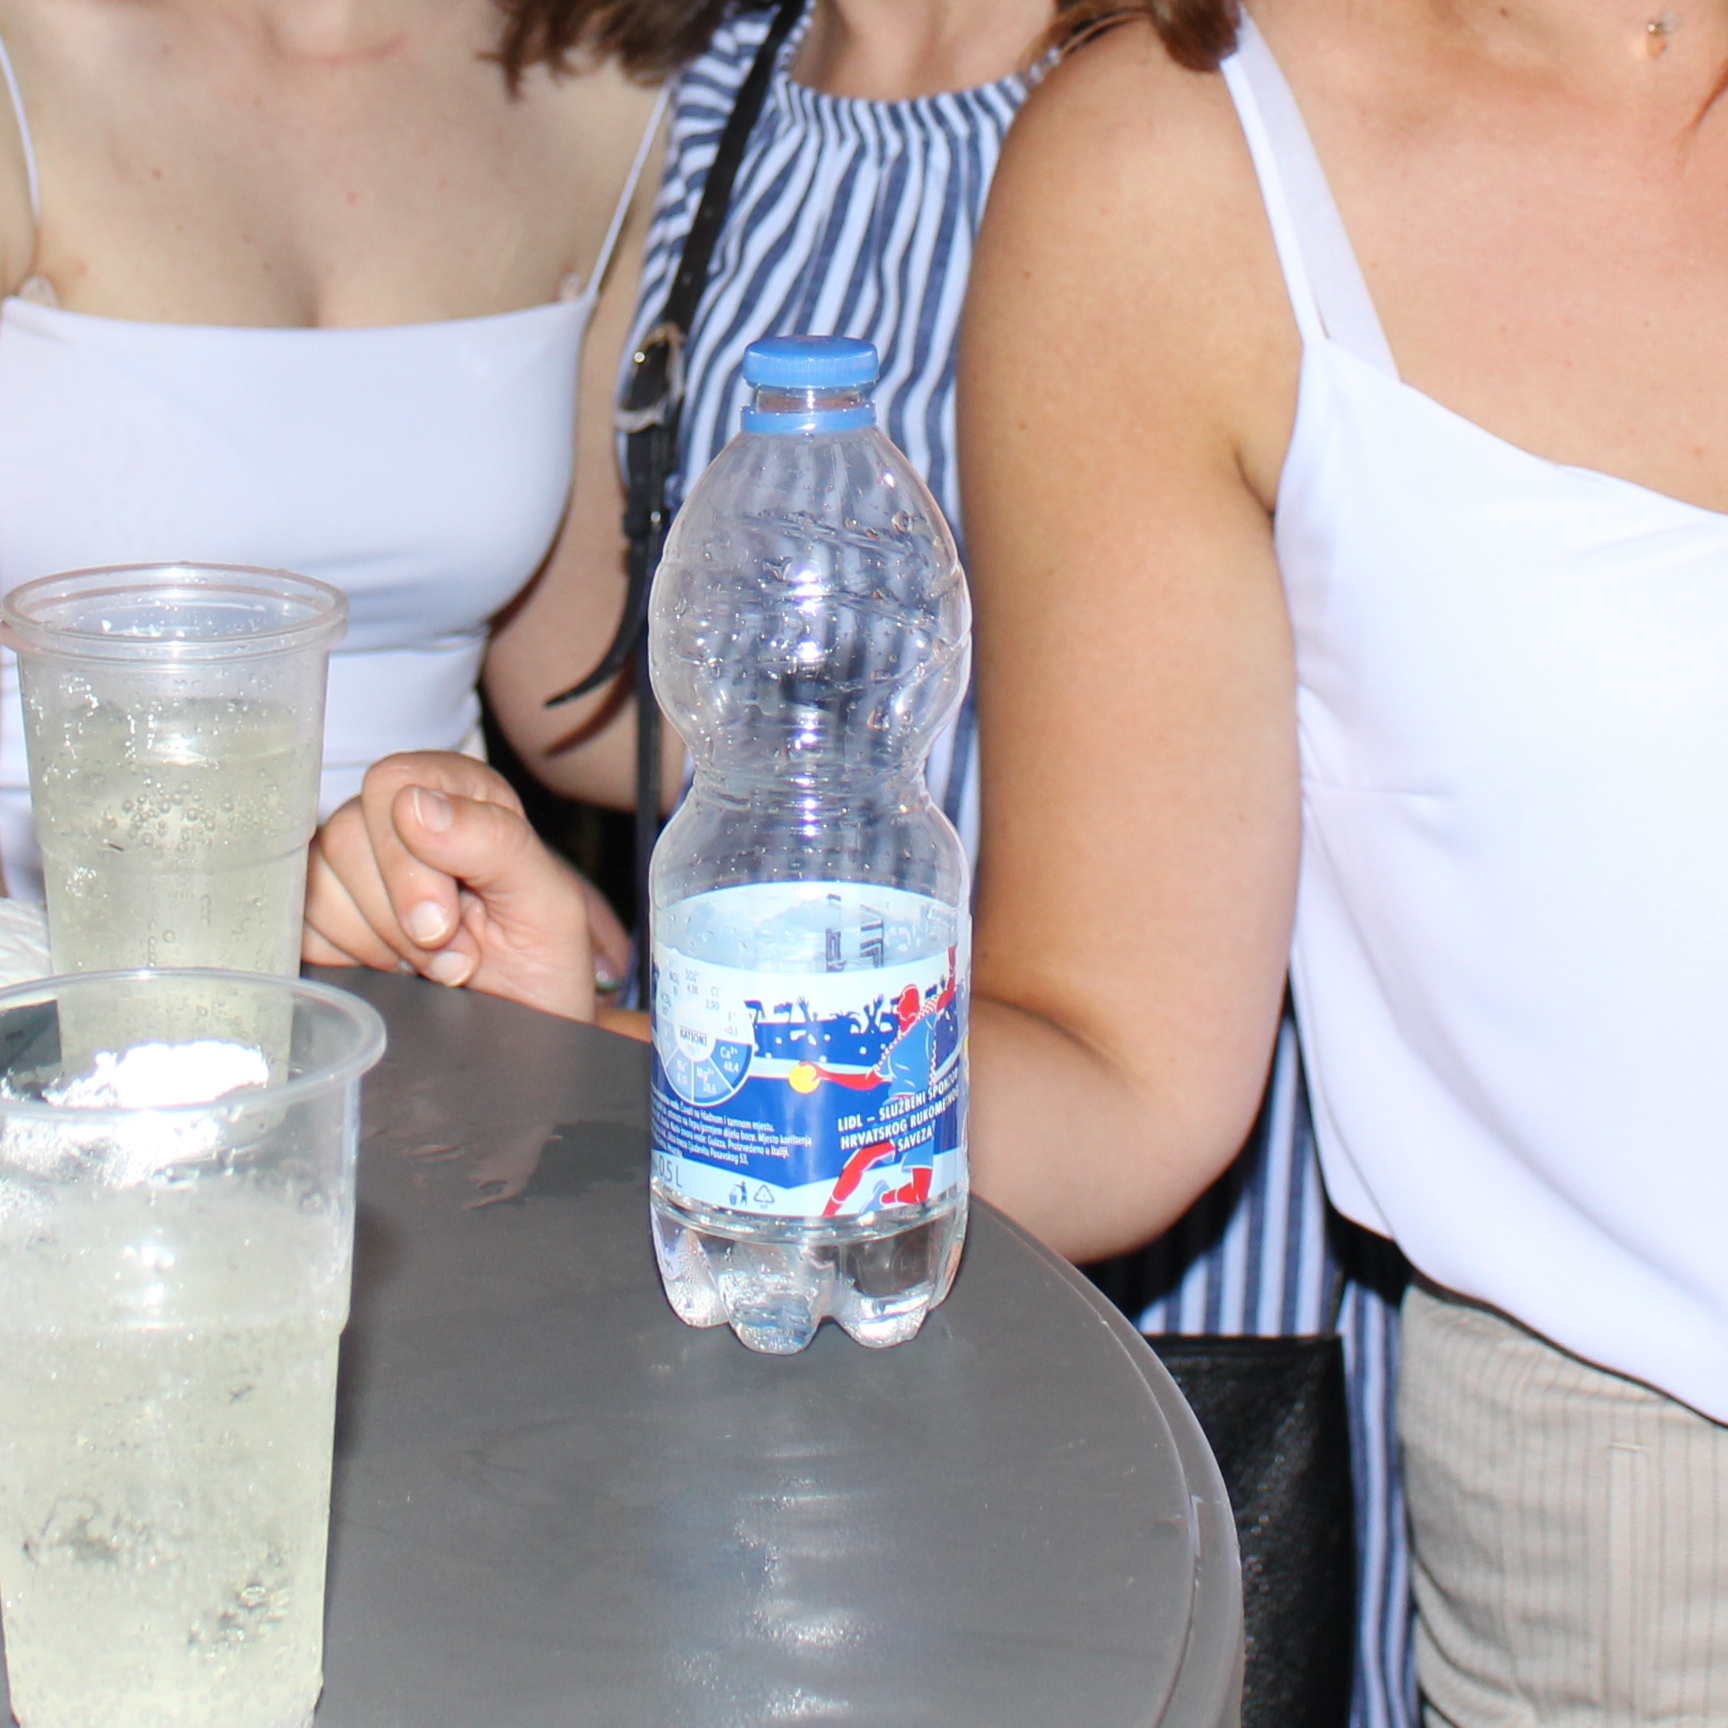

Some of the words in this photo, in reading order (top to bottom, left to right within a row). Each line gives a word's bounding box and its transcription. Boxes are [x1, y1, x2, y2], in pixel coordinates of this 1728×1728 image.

[838, 1114, 863, 1133] LIDL
[879, 1093, 927, 1122] SLUŽBENI
[840, 1119, 908, 1150] HRVATSKOG
[897, 1124, 934, 1152] SAVEZA
